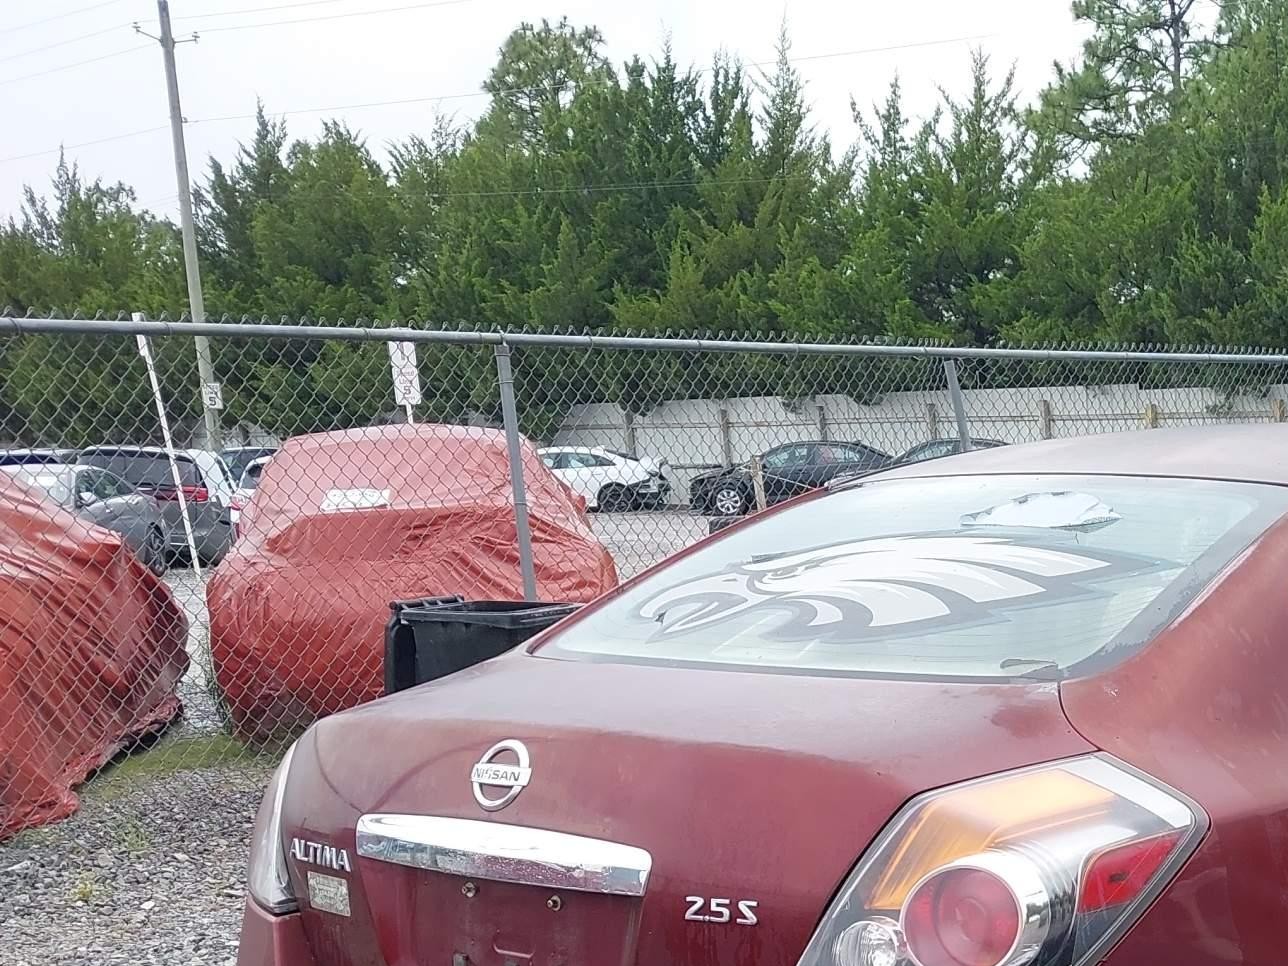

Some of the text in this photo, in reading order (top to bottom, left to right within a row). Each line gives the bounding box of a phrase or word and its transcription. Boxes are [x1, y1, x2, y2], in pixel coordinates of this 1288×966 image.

[402, 385, 411, 395] 5
[208, 396, 217, 406] 5
[473, 767, 521, 782] NISSAN
[289, 837, 351, 873] ALTIMA
[684, 895, 759, 926] 2.5 S
